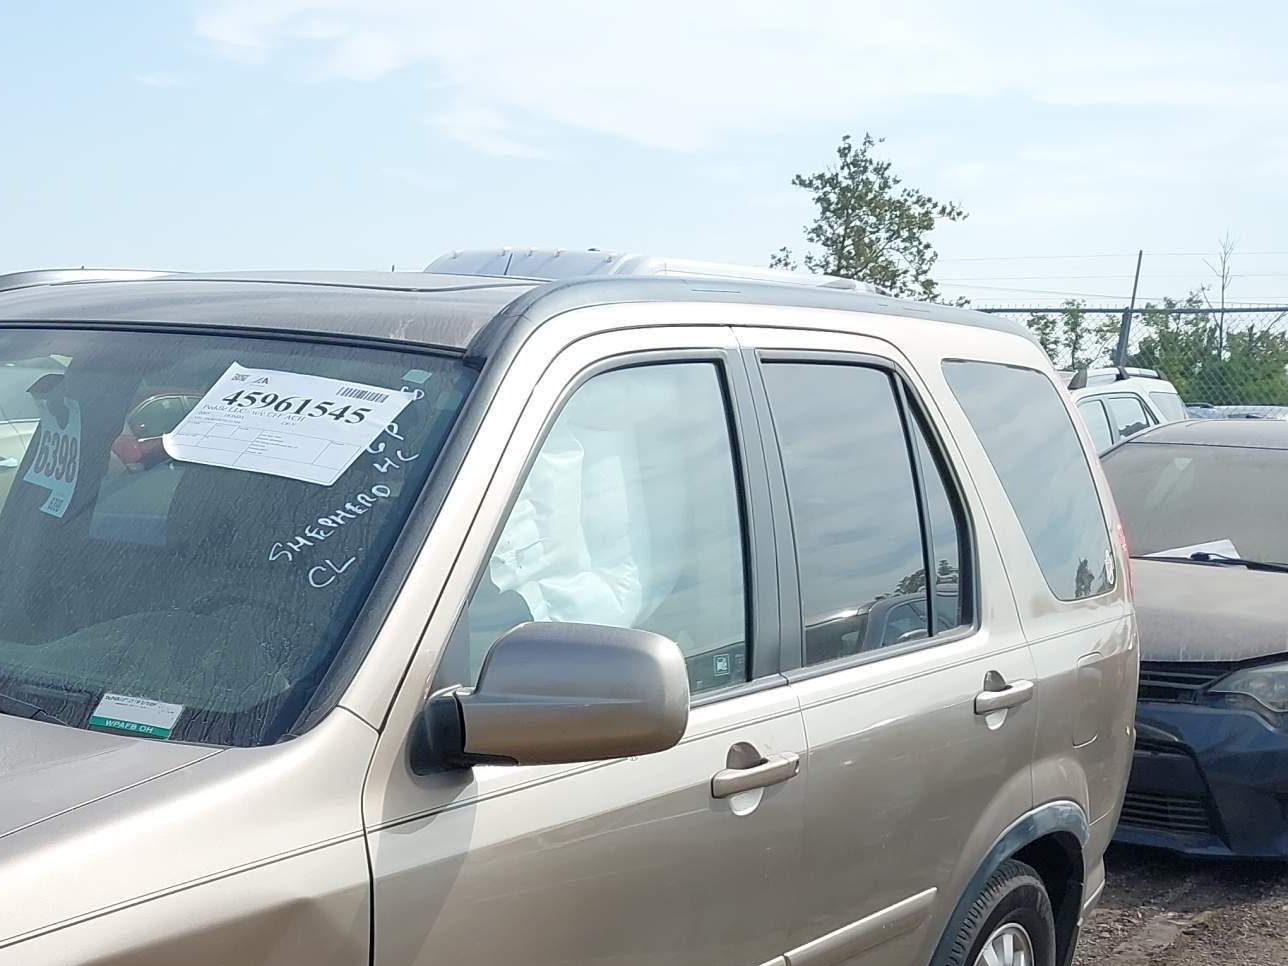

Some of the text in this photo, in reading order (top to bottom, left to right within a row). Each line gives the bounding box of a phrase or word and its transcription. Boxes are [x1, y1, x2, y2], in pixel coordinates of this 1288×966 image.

[221, 389, 372, 425] 45961545
[32, 429, 78, 484] 6398
[104, 719, 138, 730] WPAFB
